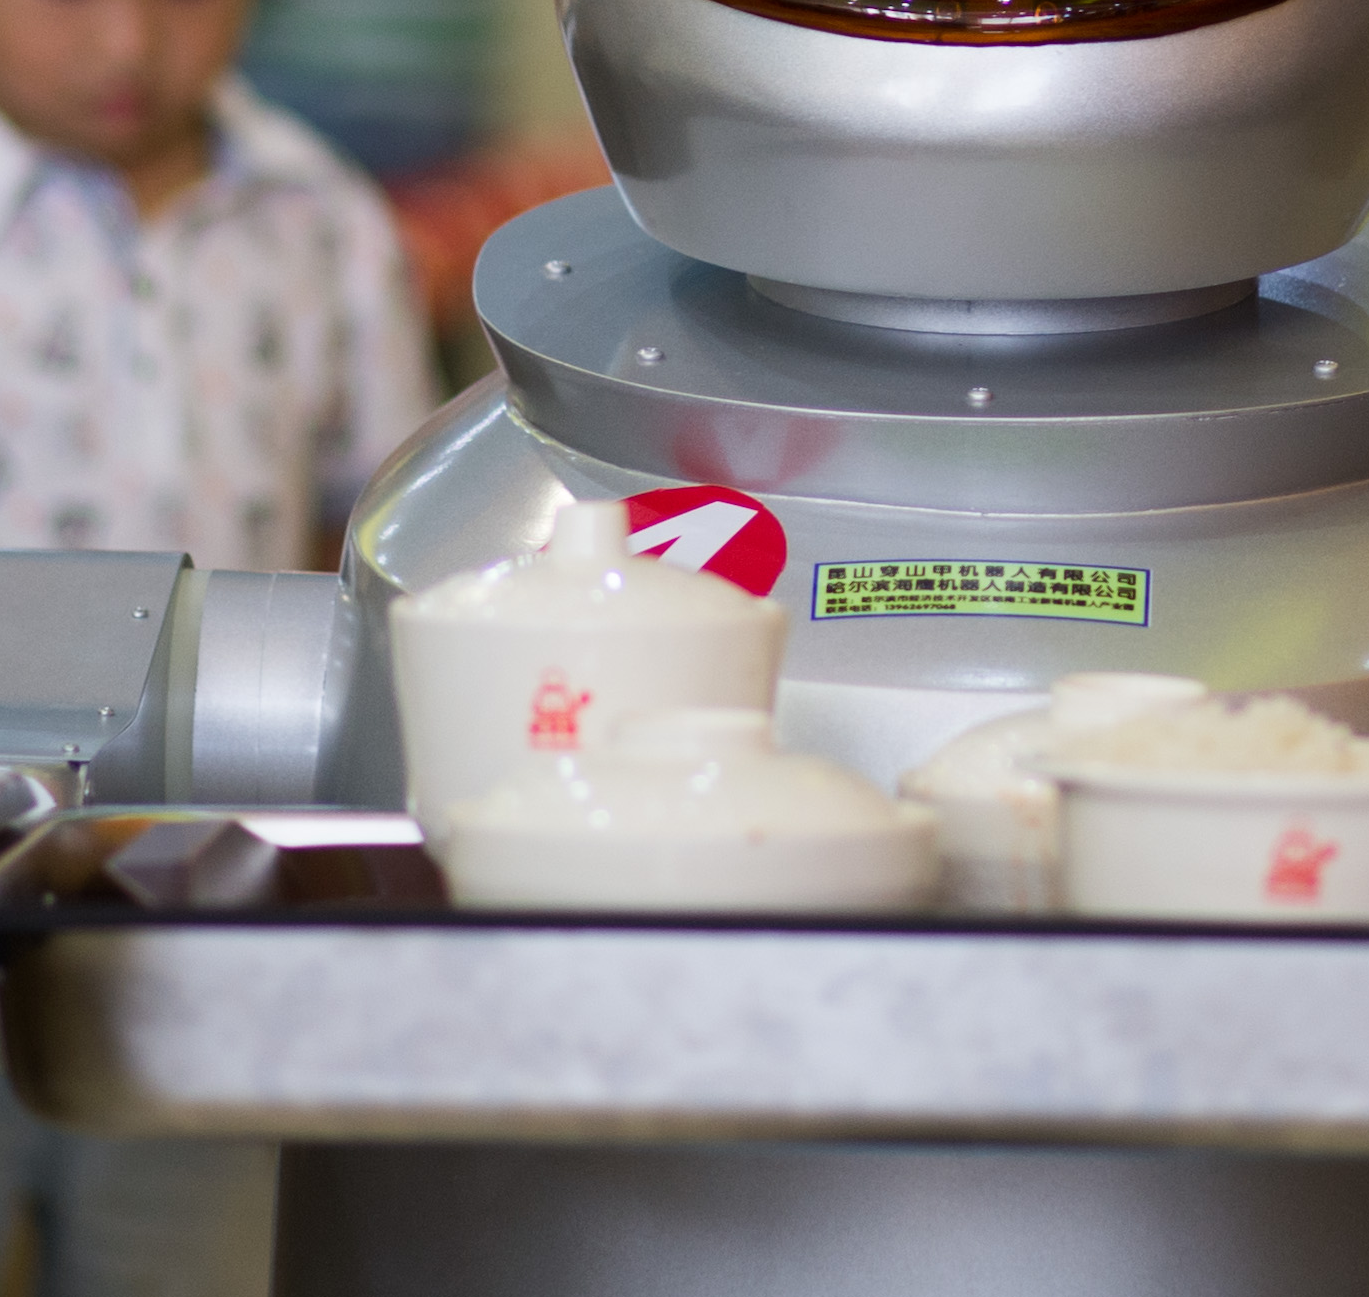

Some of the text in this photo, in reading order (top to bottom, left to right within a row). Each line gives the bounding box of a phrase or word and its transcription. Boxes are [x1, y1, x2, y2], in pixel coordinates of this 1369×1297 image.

[826, 565, 1137, 585] 昆山穿山甲机器人有限公司
